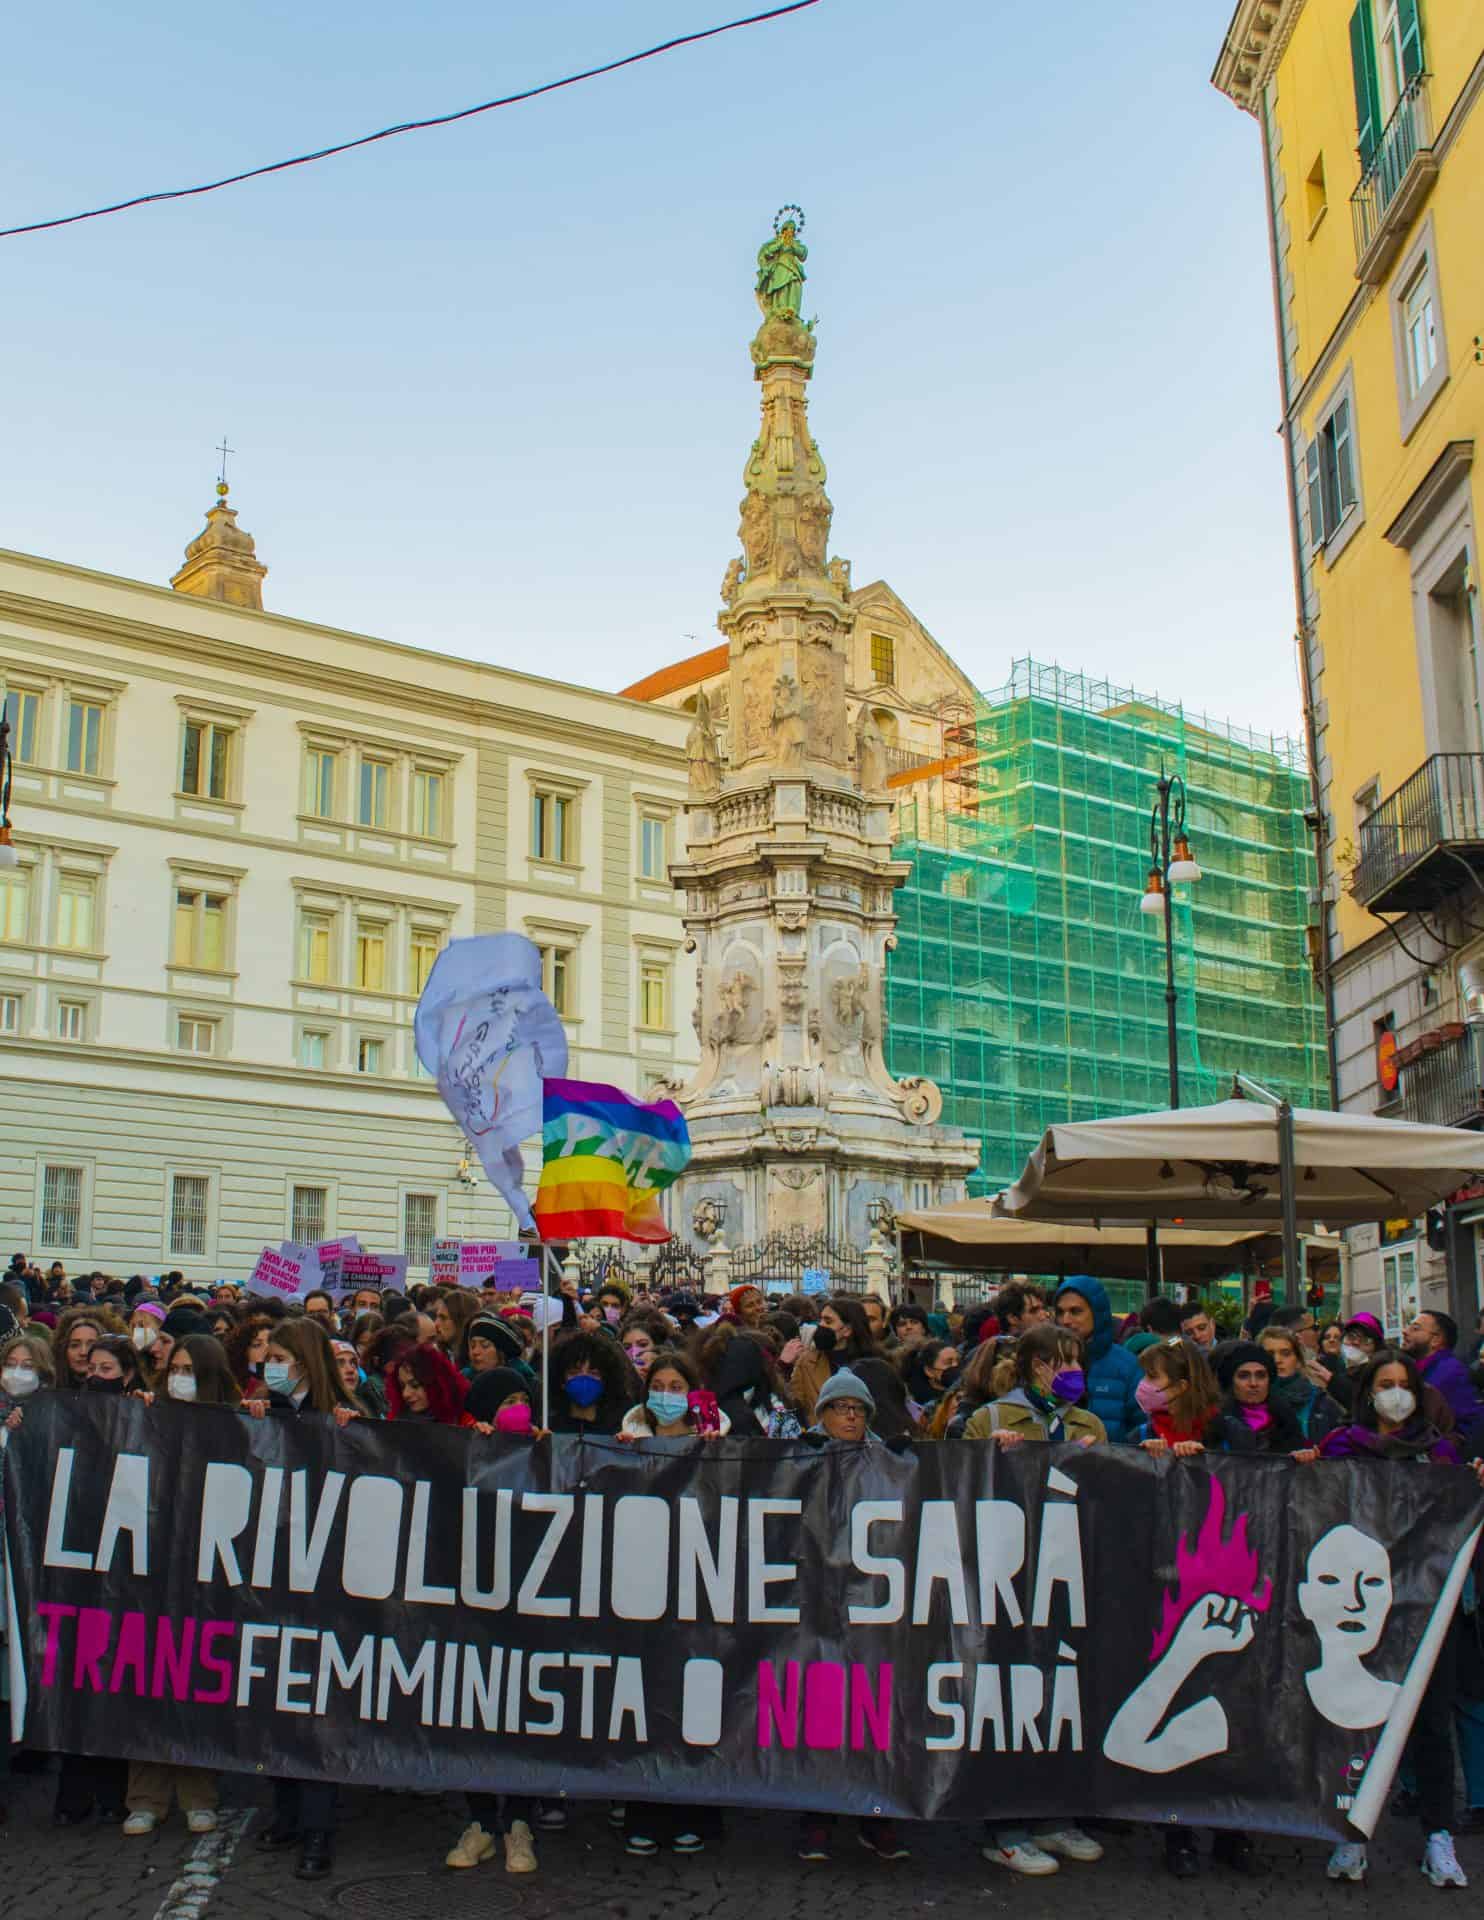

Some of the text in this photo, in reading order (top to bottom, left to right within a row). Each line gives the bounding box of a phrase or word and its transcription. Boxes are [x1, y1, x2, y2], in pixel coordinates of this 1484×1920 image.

[43, 1447, 1087, 1628] LA RIVOLUZIONE SARÀ
[36, 1602, 1084, 1753] TRANSFEMMINISTA O NON SARÀ
